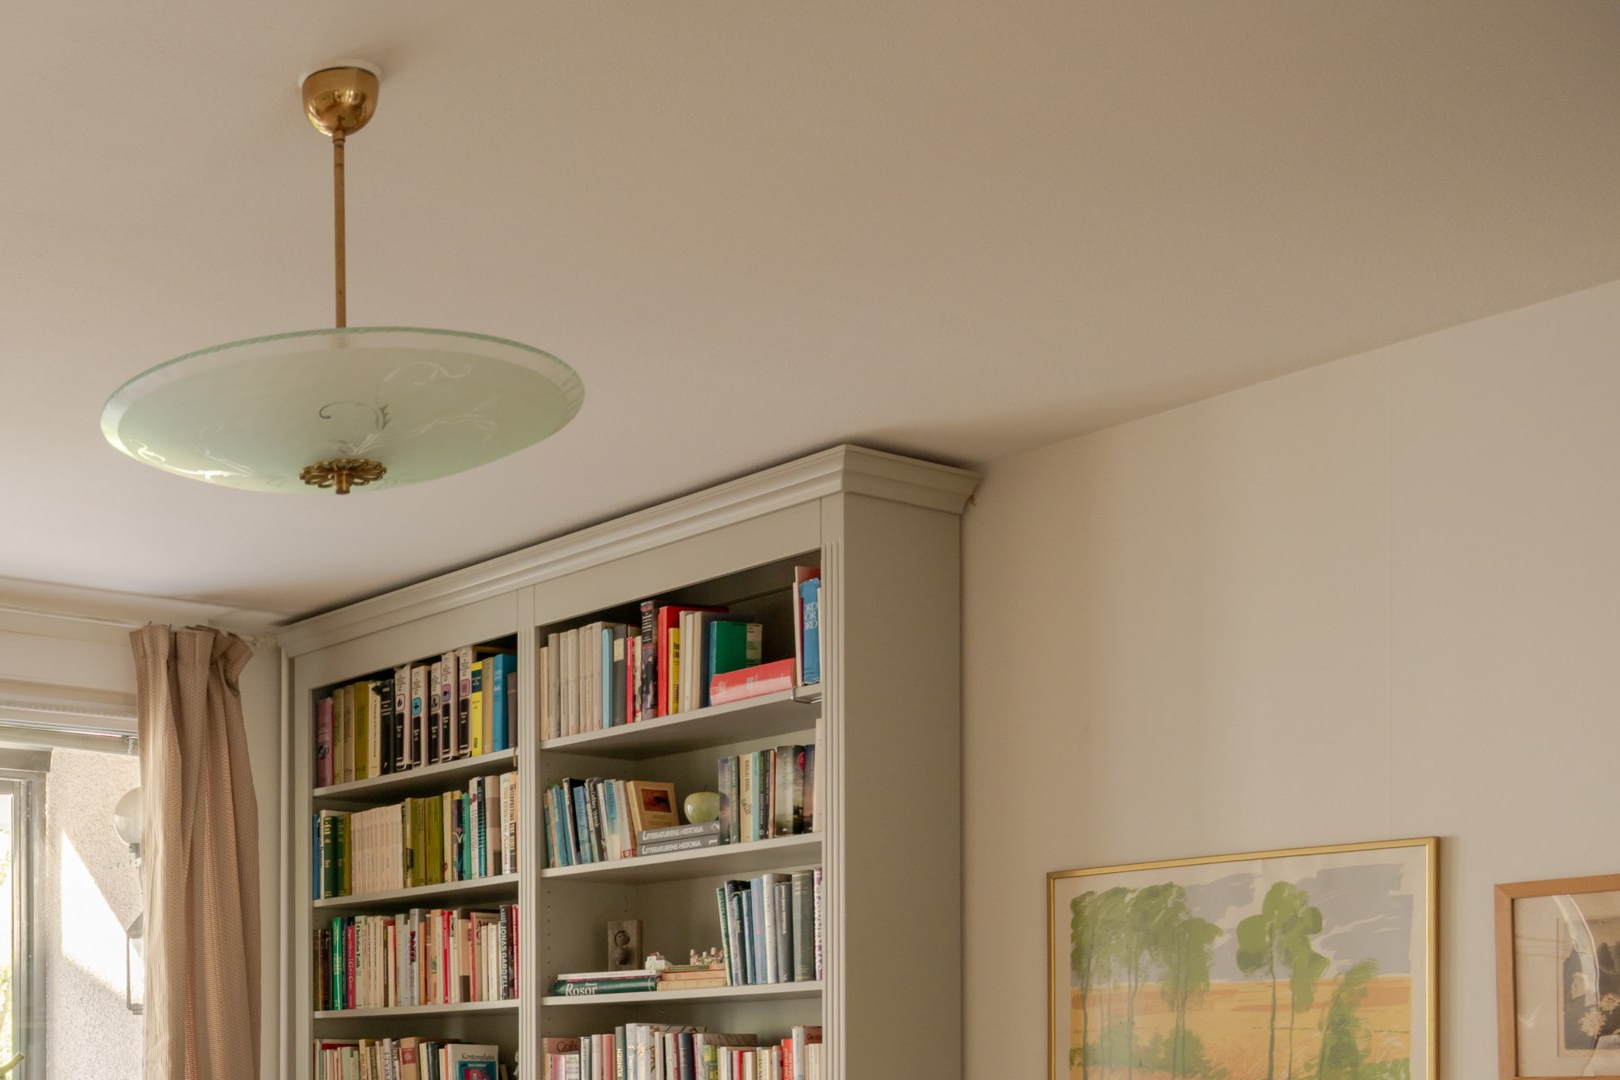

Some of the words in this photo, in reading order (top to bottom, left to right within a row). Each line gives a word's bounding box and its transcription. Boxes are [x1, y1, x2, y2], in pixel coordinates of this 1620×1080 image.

[500, 926, 508, 952] JONAS
[501, 952, 509, 988] GARDELL
[565, 982, 598, 996] Rosor
